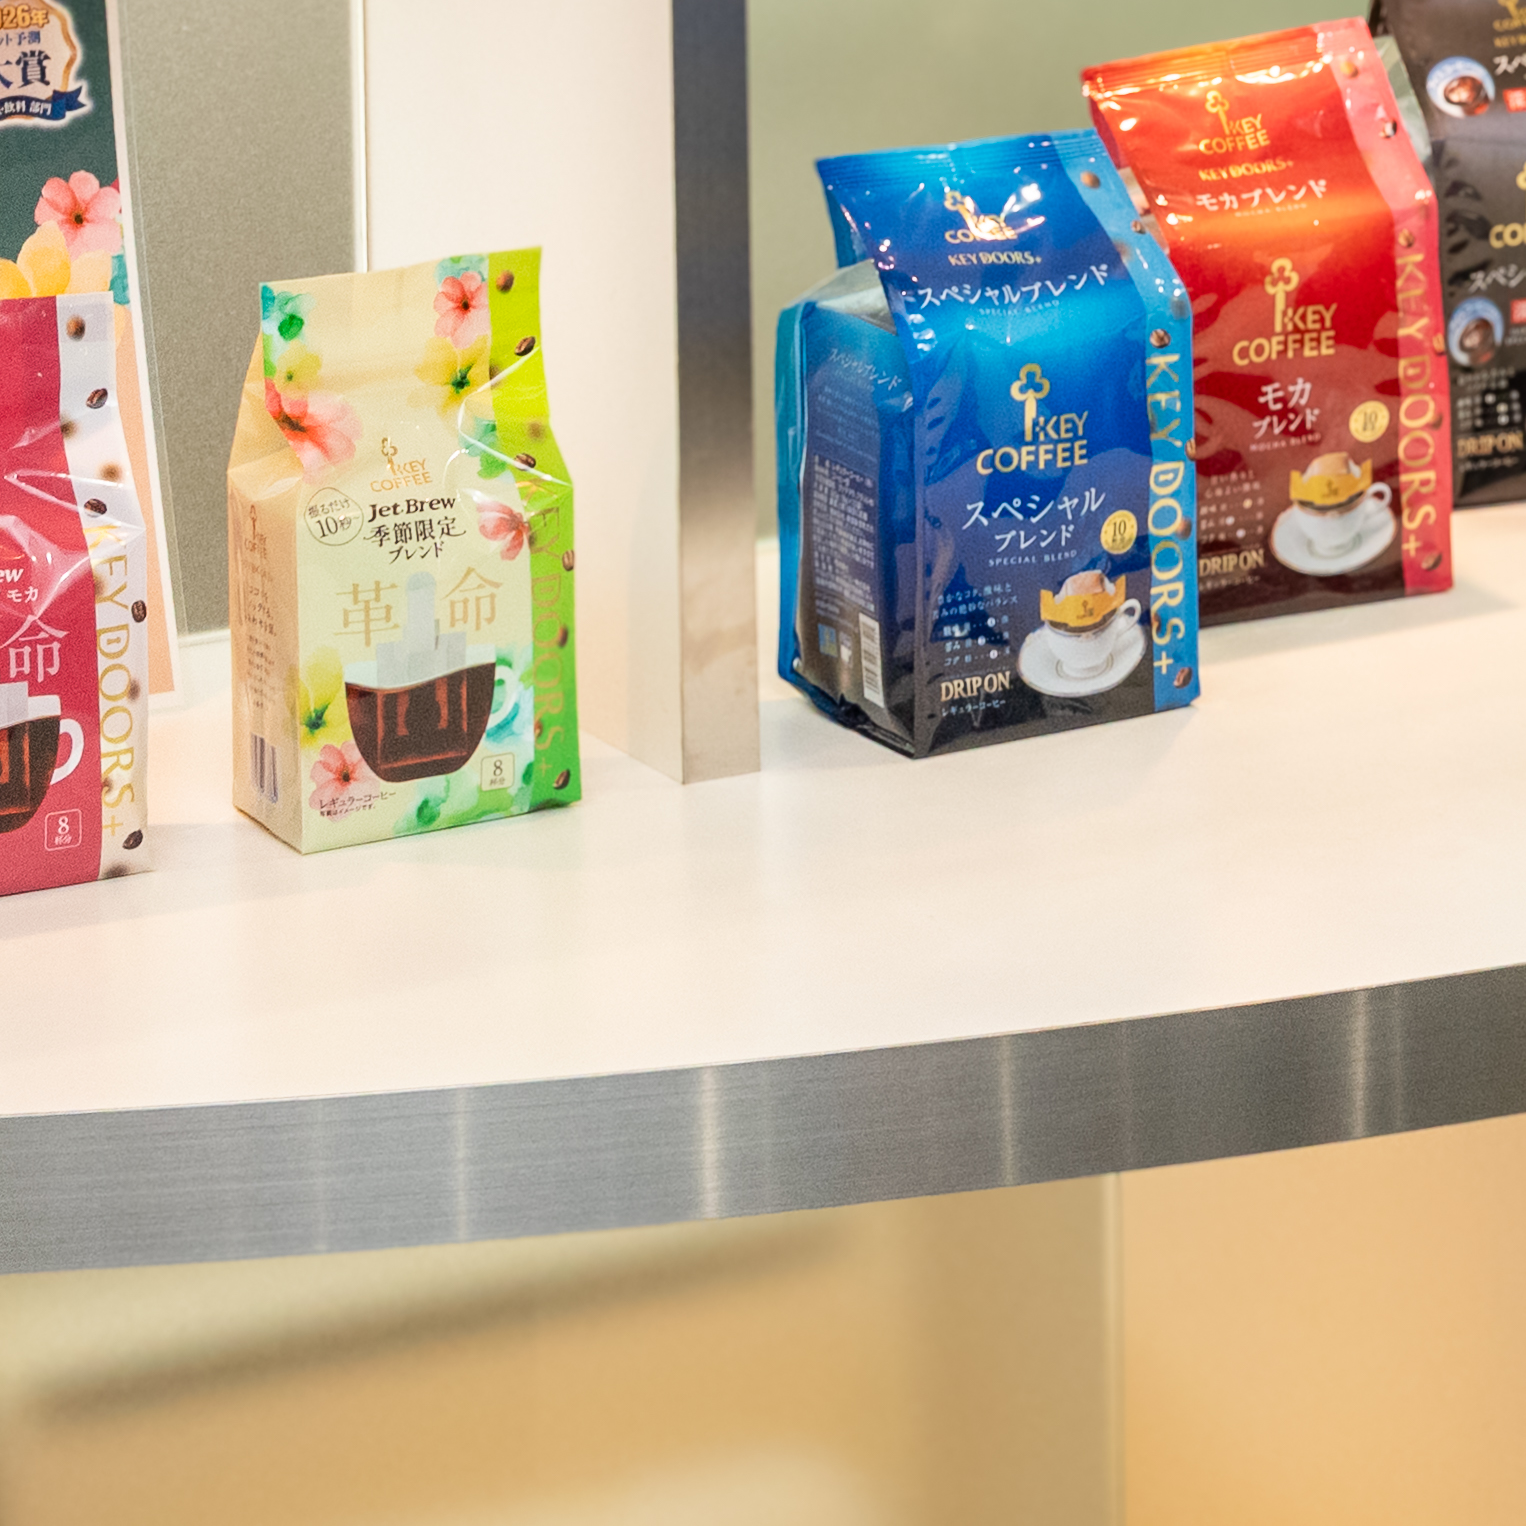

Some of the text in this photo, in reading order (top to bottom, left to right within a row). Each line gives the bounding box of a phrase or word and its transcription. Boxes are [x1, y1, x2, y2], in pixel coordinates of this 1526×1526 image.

[0, 4, 50, 30] 26年
[1198, 129, 1271, 155] COFFEE
[1195, 178, 1327, 212] モカブレンド
[918, 263, 1109, 310] スペシャルブレンド
[1283, 302, 1338, 331] KEY
[1232, 330, 1336, 367] COFFEE
[1257, 377, 1313, 411] モカ
[1035, 410, 1089, 442] KEY
[1252, 408, 1321, 440] ブレンド
[975, 439, 1088, 476] COFFEE
[1398, 355, 1438, 558] DOORS+
[369, 471, 433, 493] COFFEE
[961, 486, 1106, 531] スペシャル
[1146, 353, 1186, 675] KEY DOORS+
[368, 515, 462, 548] 季節限定
[994, 524, 1075, 553] ブレンド
[1111, 519, 1127, 536] 10
[388, 541, 445, 565] ブレンド
[988, 549, 1078, 568] SPECIAL BLEND
[1198, 548, 1265, 577] DRIP ON
[7, 585, 39, 604] モカ
[0, 613, 70, 684] 命
[940, 670, 1011, 702] DRIP ON
[95, 623, 136, 837] DOORS+
[492, 759, 504, 777] 8
[319, 790, 397, 810] レギュラーコーヒー
[57, 816, 70, 835] 8
